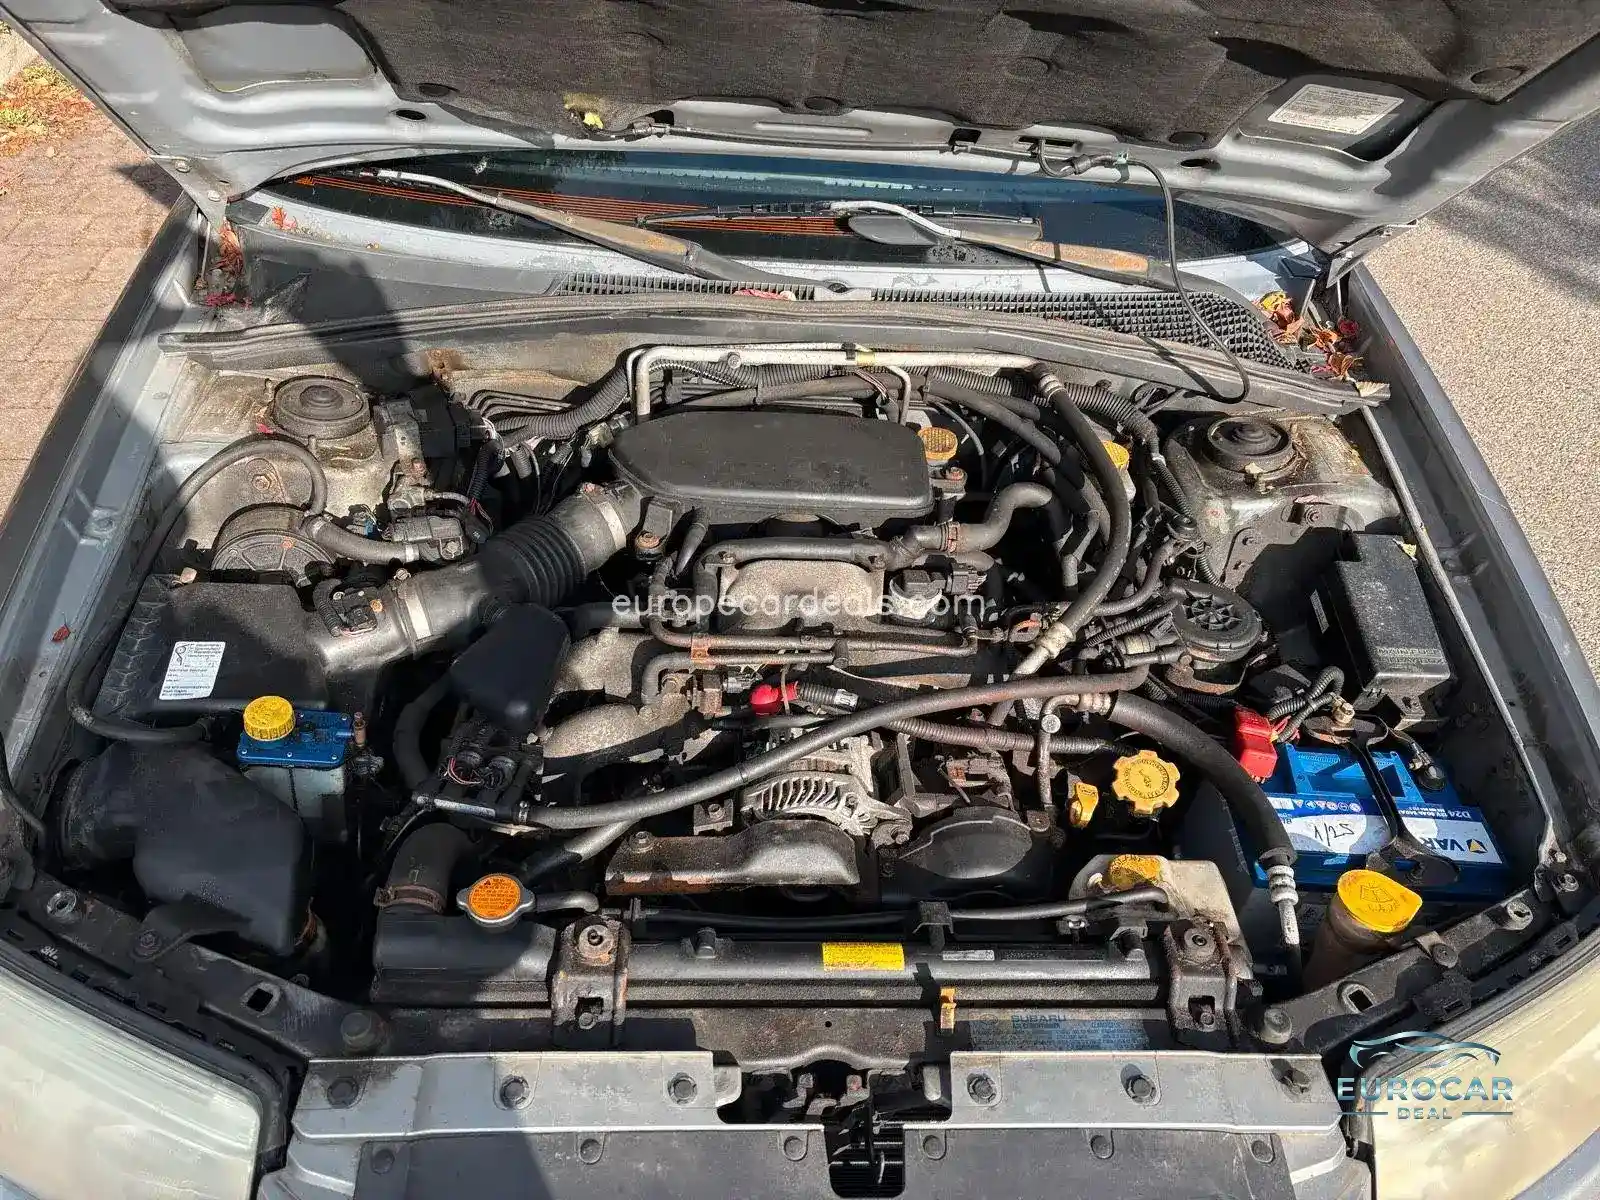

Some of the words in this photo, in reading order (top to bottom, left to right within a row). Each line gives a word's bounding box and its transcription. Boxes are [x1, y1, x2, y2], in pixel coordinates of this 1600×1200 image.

[1447, 809, 1472, 819] D24
[1314, 822, 1355, 847] 1/25
[1419, 836, 1466, 852] VAR
[1012, 1014, 1067, 1023] SUBARU
